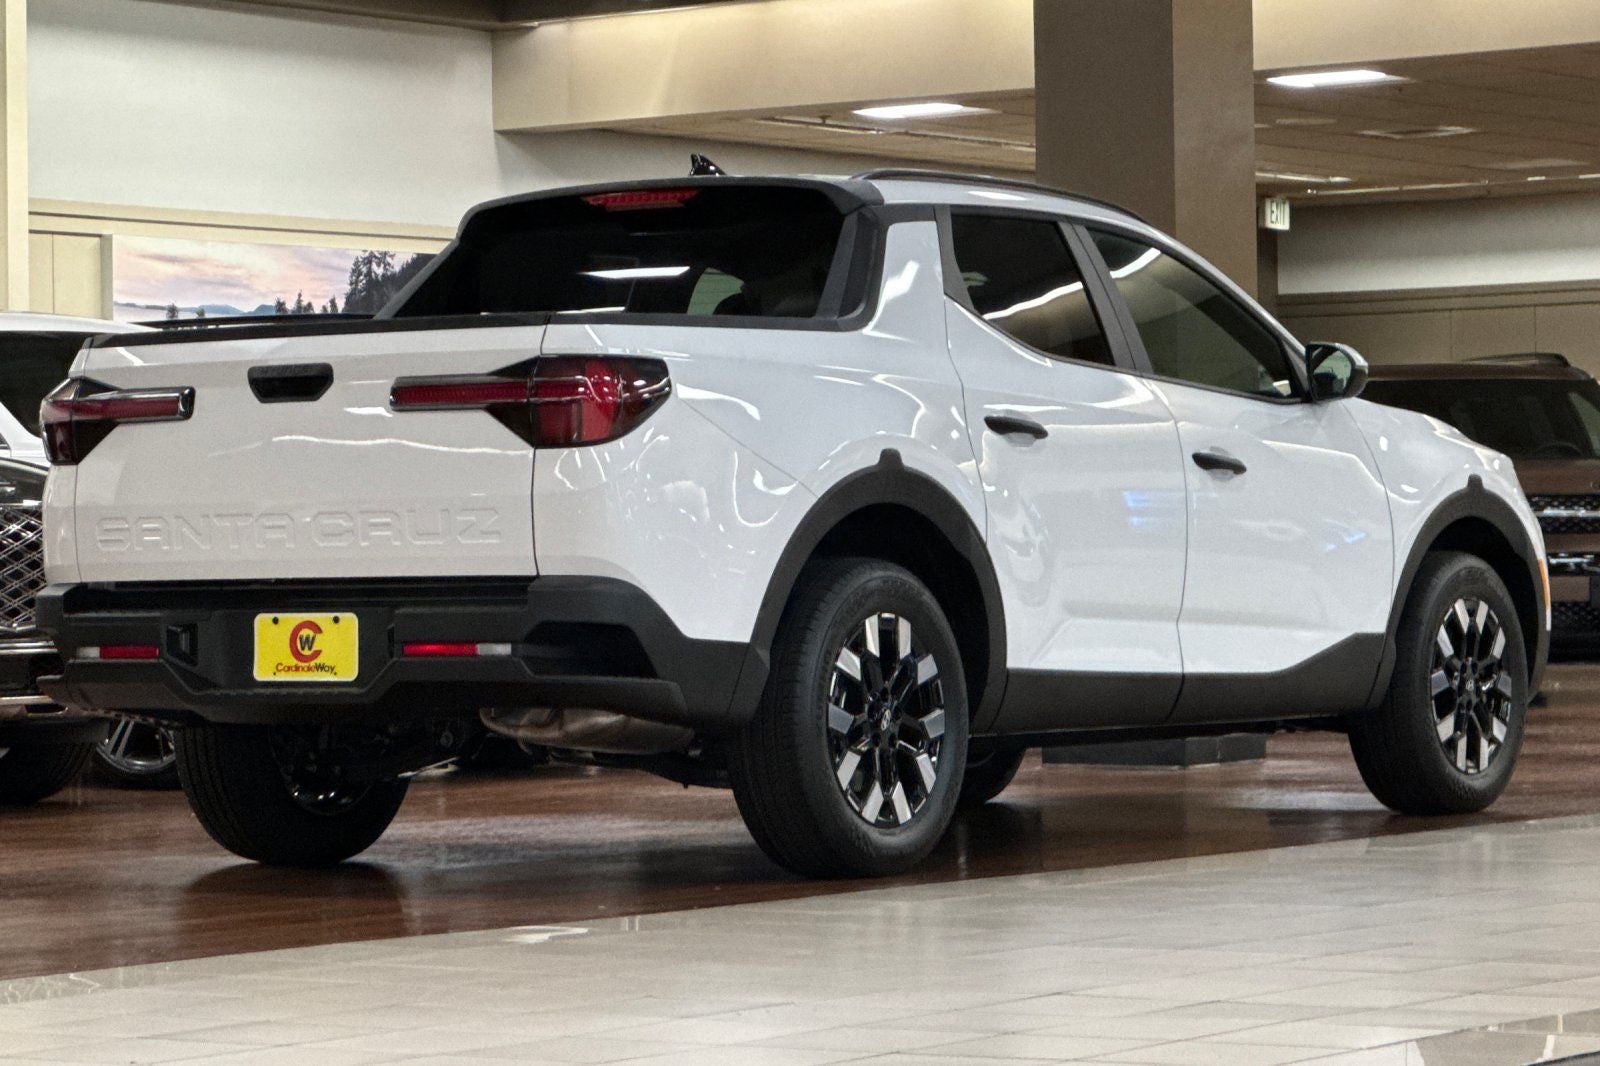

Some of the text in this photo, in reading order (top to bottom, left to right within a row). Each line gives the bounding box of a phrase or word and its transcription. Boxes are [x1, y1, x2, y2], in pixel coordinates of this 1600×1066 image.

[1270, 199, 1287, 225] EXIT
[96, 508, 500, 551] SANTA CRUZ
